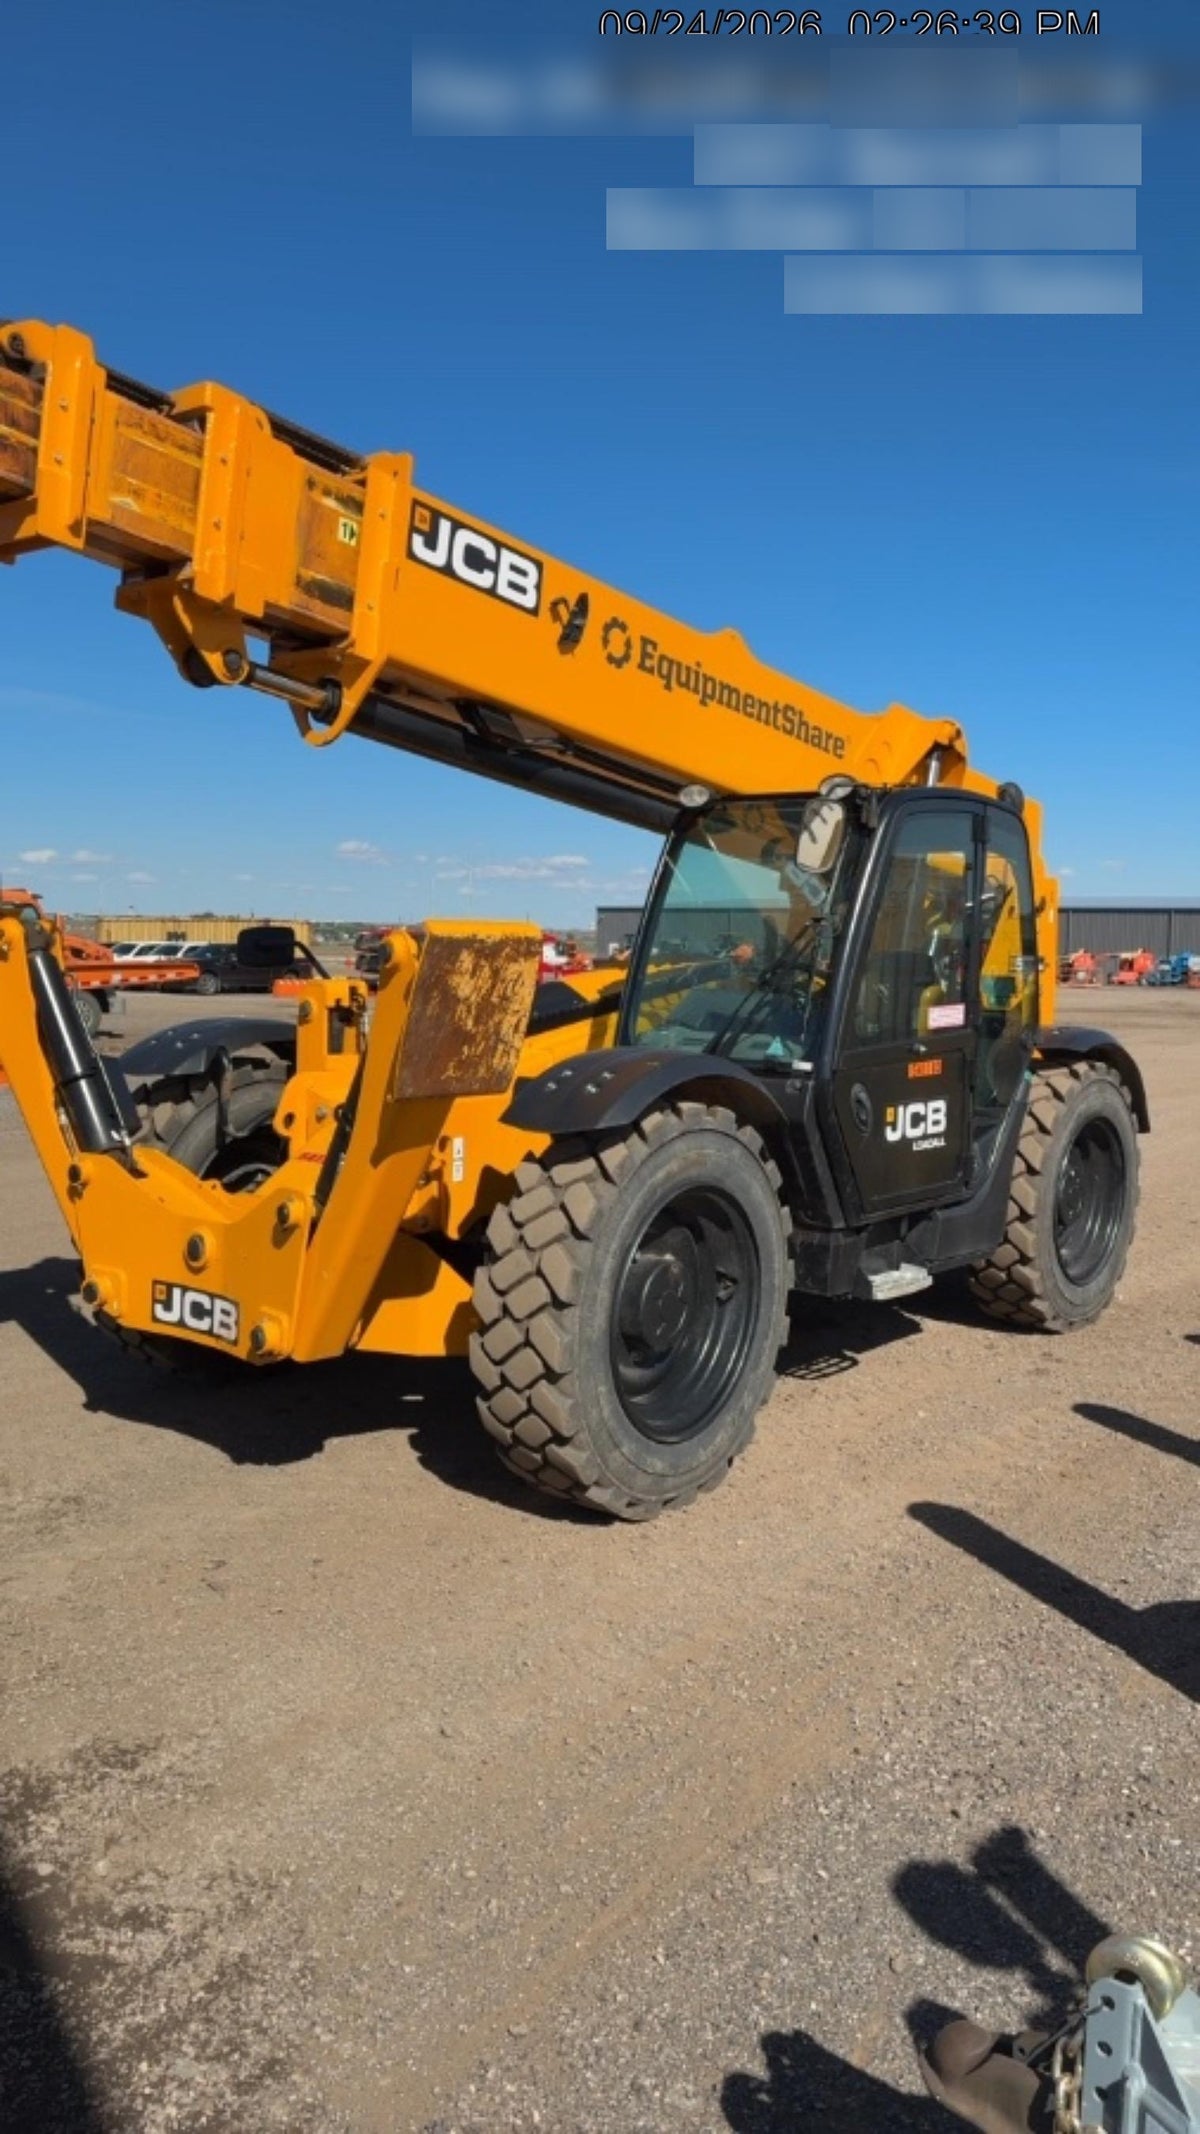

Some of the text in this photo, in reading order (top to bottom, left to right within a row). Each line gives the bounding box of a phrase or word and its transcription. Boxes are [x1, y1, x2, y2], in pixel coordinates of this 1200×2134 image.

[410, 517, 540, 611] JCB
[637, 634, 846, 760] EquipmentShare
[885, 1100, 947, 1142] JCB
[153, 1287, 239, 1341] JCB
